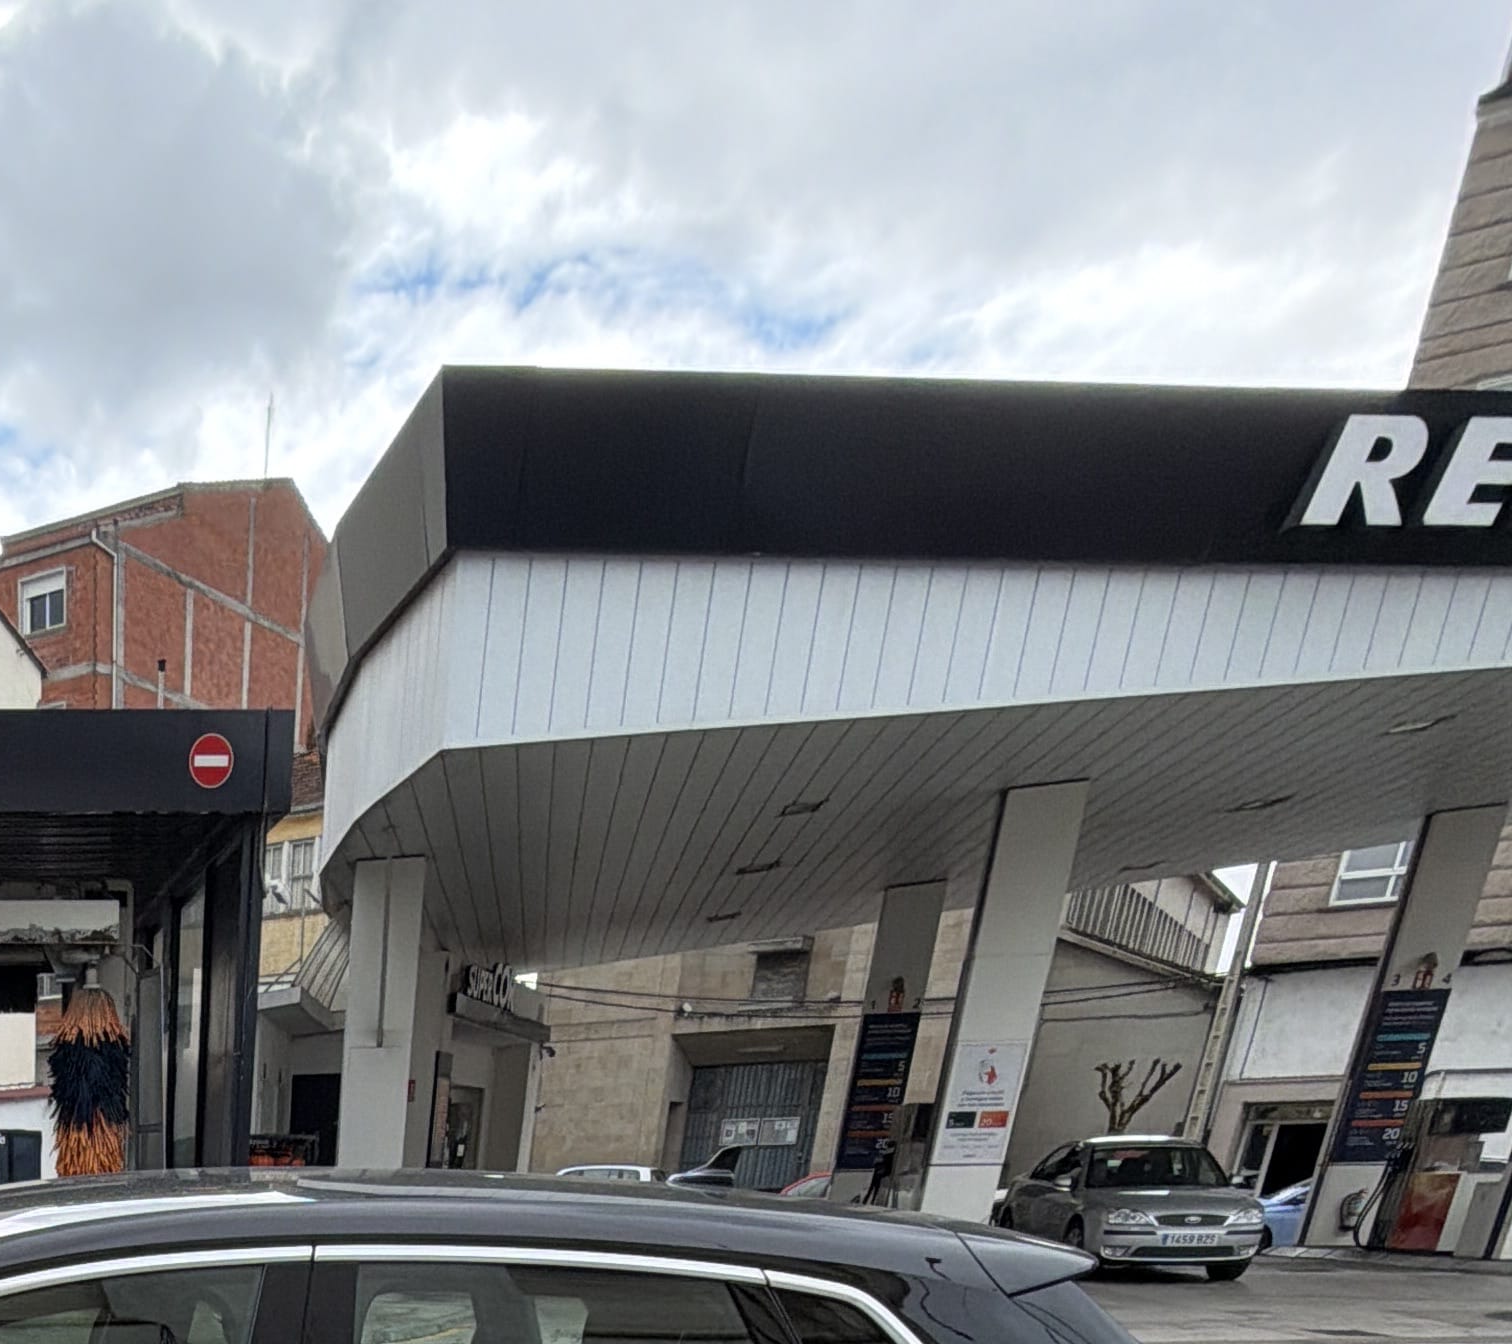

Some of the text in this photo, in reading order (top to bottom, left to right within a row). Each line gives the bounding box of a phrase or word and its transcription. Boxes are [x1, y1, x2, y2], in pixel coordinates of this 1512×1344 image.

[1299, 413, 1512, 527] RE
[1391, 973, 1401, 987] 3
[1442, 972, 1452, 985] 4
[1417, 1042, 1427, 1054] 5
[1401, 1071, 1418, 1083] 10
[887, 1086, 901, 1098] 10
[1392, 1100, 1408, 1112] 15
[1382, 1127, 1400, 1140] 20
